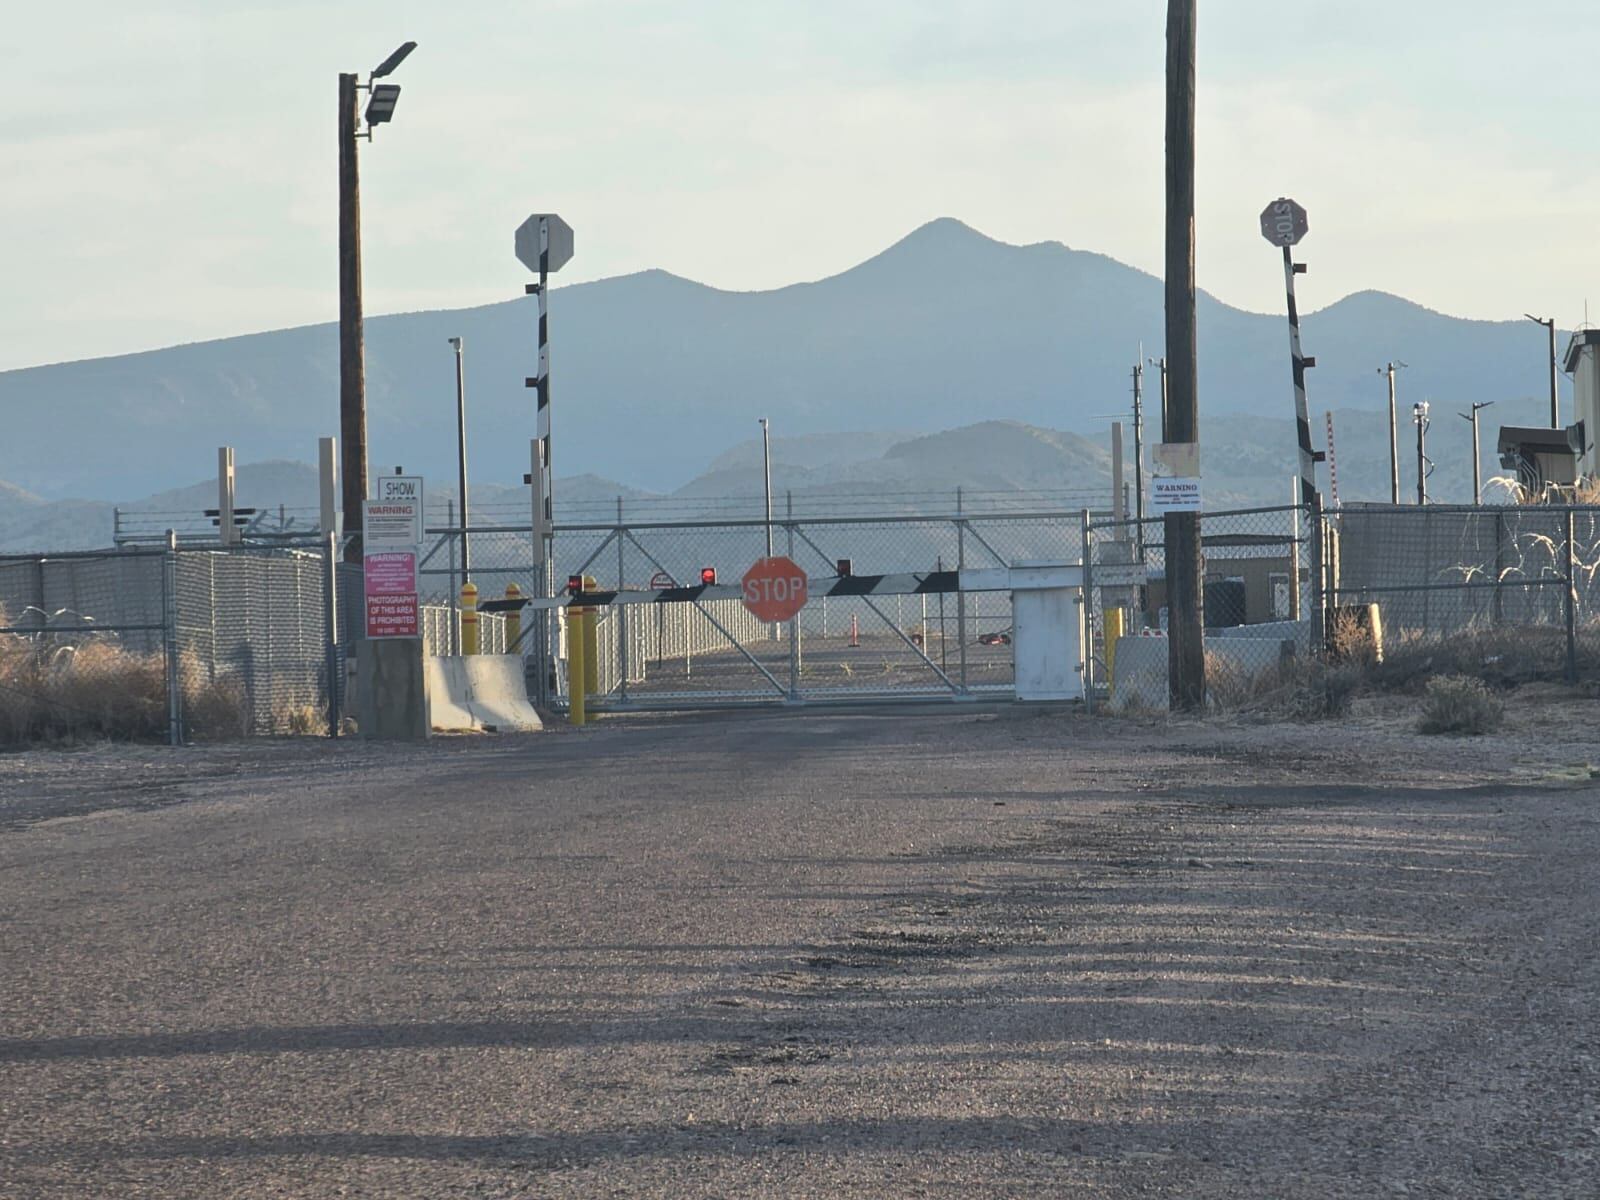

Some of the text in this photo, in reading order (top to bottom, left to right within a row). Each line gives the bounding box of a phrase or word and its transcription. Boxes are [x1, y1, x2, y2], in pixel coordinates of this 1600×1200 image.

[1274, 203, 1294, 243] STOP
[386, 482, 415, 495] SHOW
[368, 506, 412, 514] WARNING
[747, 576, 803, 602] STOP
[368, 596, 416, 604] PHOTOGRAPHY
[377, 616, 415, 624] PROHIBITED
